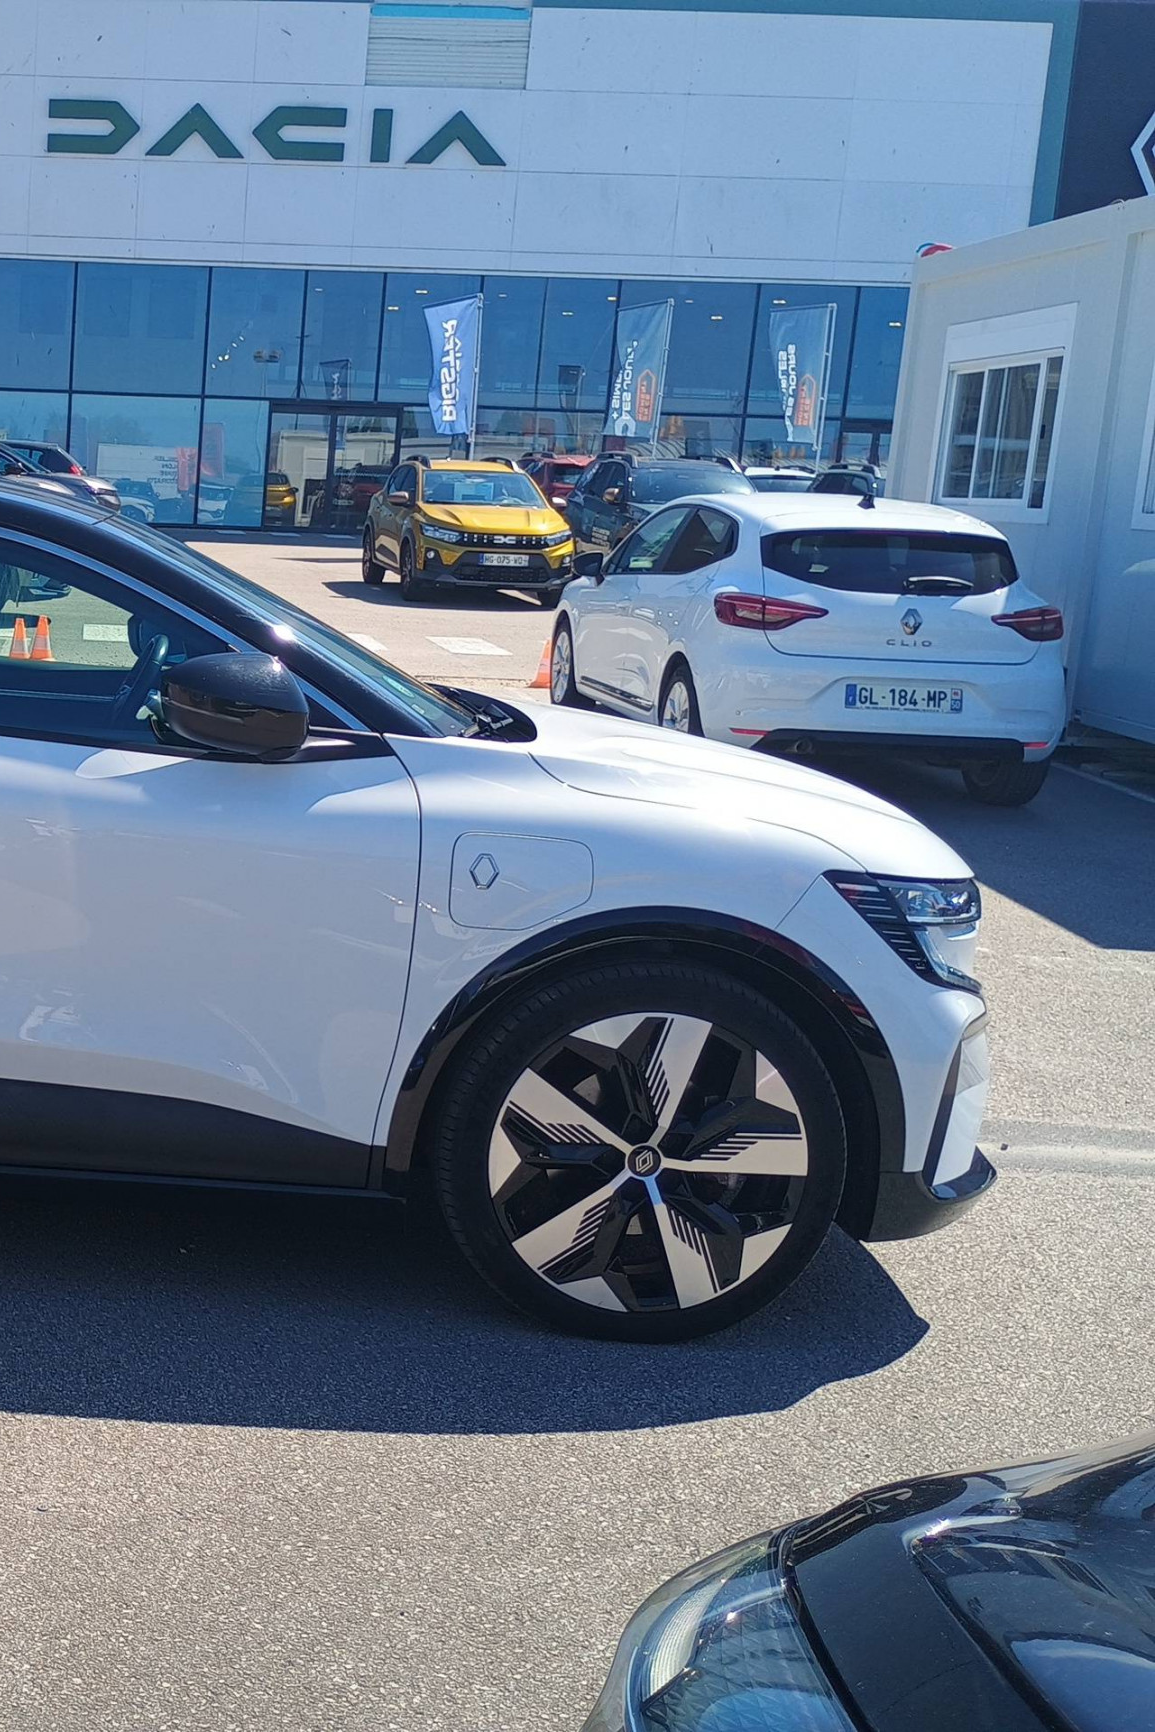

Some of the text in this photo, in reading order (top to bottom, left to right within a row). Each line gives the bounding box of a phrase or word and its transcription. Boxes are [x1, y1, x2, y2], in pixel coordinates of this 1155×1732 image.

[46, 98, 506, 166] DACIA
[886, 639, 932, 647] CLIO
[858, 687, 948, 708] GL-184-MP
